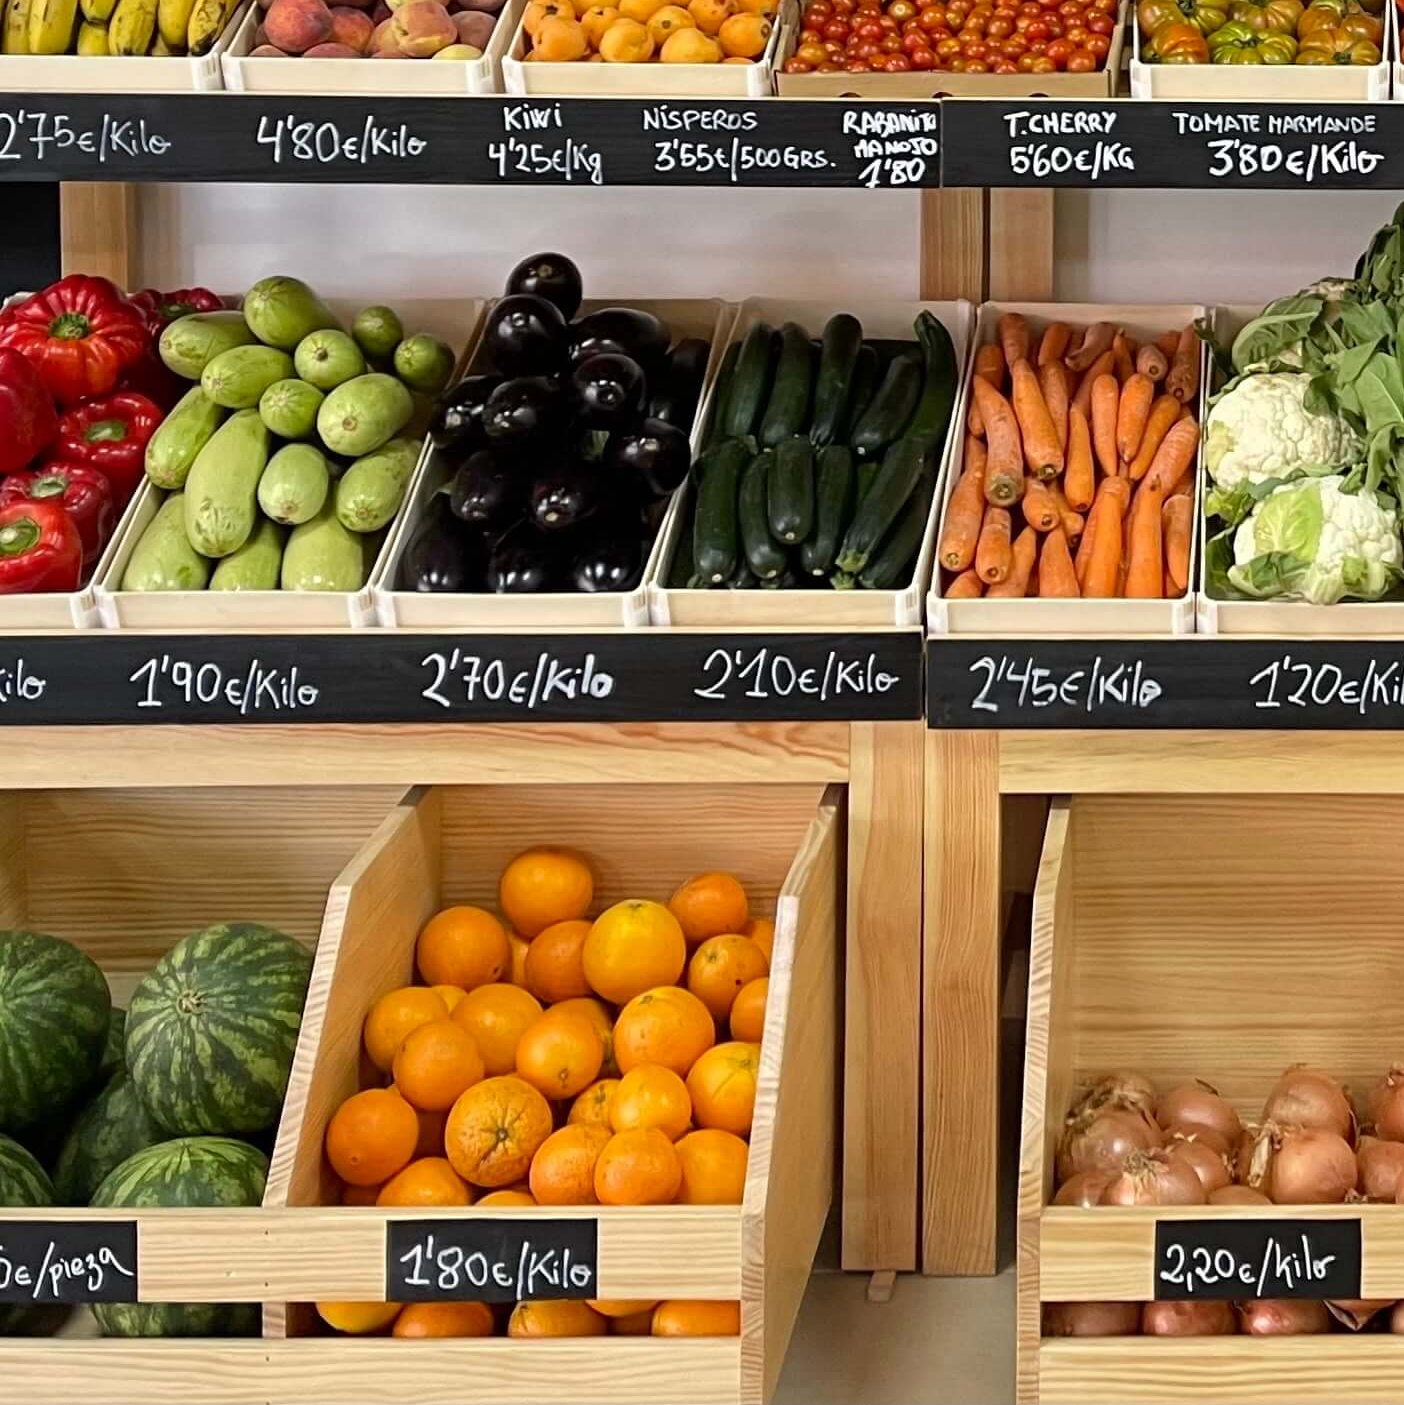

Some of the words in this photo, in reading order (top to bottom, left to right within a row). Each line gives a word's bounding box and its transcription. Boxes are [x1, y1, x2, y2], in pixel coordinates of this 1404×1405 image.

[0, 109, 172, 162] 2'75€/Kilo
[256, 114, 427, 164] 4'80€/Kilo
[853, 136, 938, 158] MANOJO
[1003, 111, 1117, 138] T.CHERRY
[1172, 112, 1260, 134] TOMATE
[857, 157, 927, 188] 1'80
[1010, 141, 1135, 180] 5'60€/KG
[1207, 138, 1385, 182] 3'80€/Kilo
[129, 654, 319, 714] 1'90€/Kilo
[421, 648, 614, 709] 2'70€/Kilo
[694, 648, 899, 701] 2'10€/Kilo
[969, 656, 1162, 712] 2'45€/Kilo
[399, 1235, 592, 1301] 1'80€/Kilo
